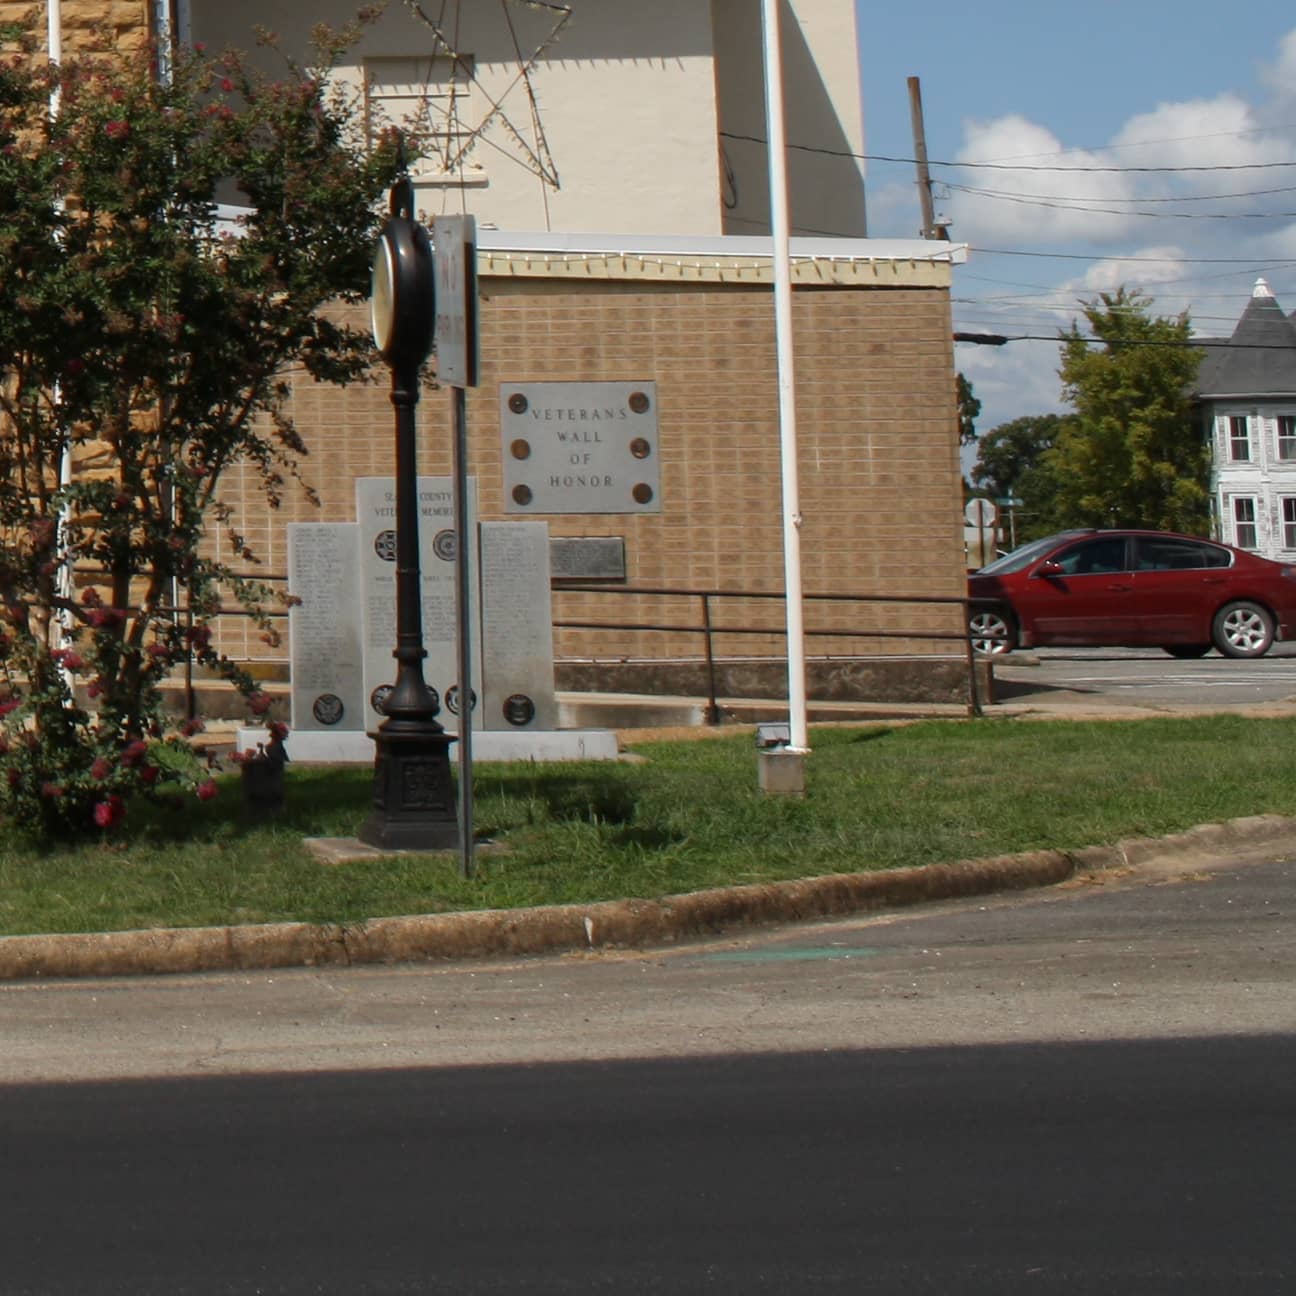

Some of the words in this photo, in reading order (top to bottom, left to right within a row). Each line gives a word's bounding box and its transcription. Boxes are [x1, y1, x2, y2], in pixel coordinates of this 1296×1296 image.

[532, 408, 627, 421] VETERANS
[557, 431, 603, 443] WALL
[569, 453, 592, 465] OF
[549, 475, 614, 487] HONOR
[419, 492, 451, 502] COUNTY
